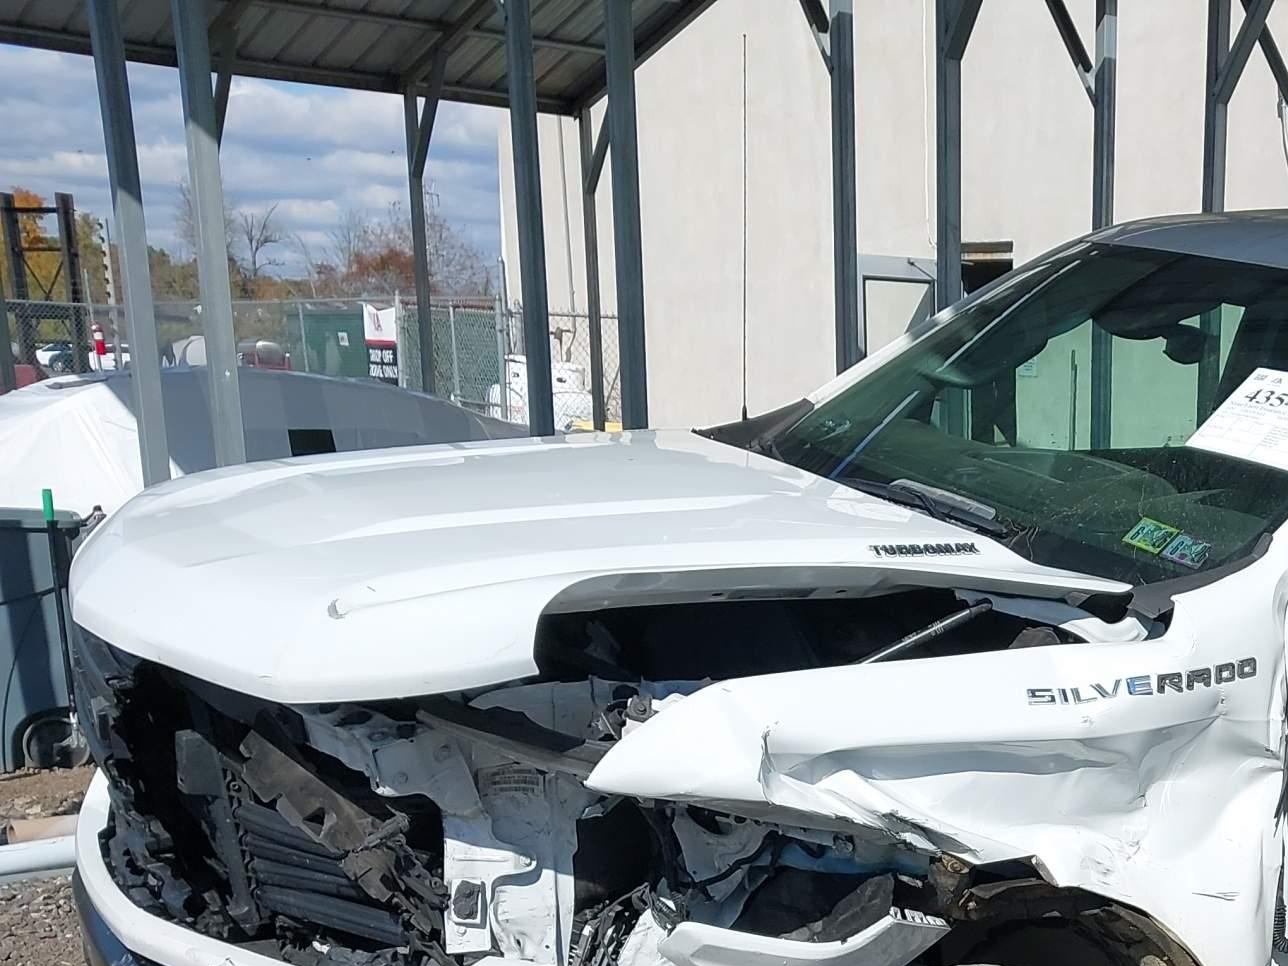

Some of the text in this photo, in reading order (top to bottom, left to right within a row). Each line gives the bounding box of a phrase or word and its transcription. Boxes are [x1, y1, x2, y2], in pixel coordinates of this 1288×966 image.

[382, 349, 394, 363] OFF
[383, 365, 398, 378] ONLY
[867, 542, 981, 558] TURBOMAX
[1026, 657, 1257, 705] SILVERADO
